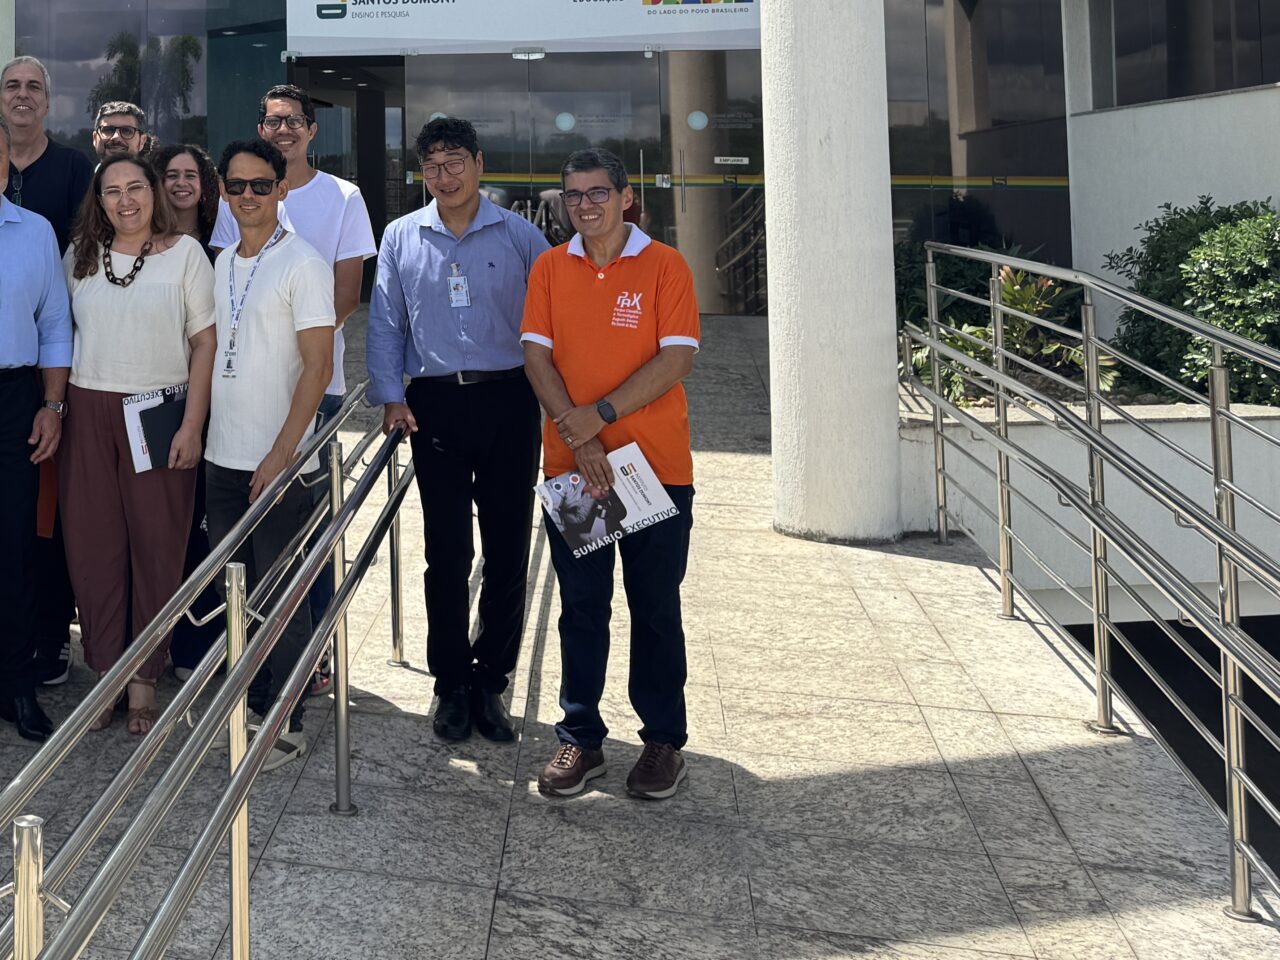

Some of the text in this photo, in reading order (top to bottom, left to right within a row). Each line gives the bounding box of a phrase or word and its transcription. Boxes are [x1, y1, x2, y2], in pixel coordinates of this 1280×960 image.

[351, 11, 375, 19] ENSINO
[381, 10, 410, 19] PESQUISA
[123, 389, 163, 406] EXECUTIVO
[573, 506, 679, 559] SUMÁRIO EXECUTIVO
